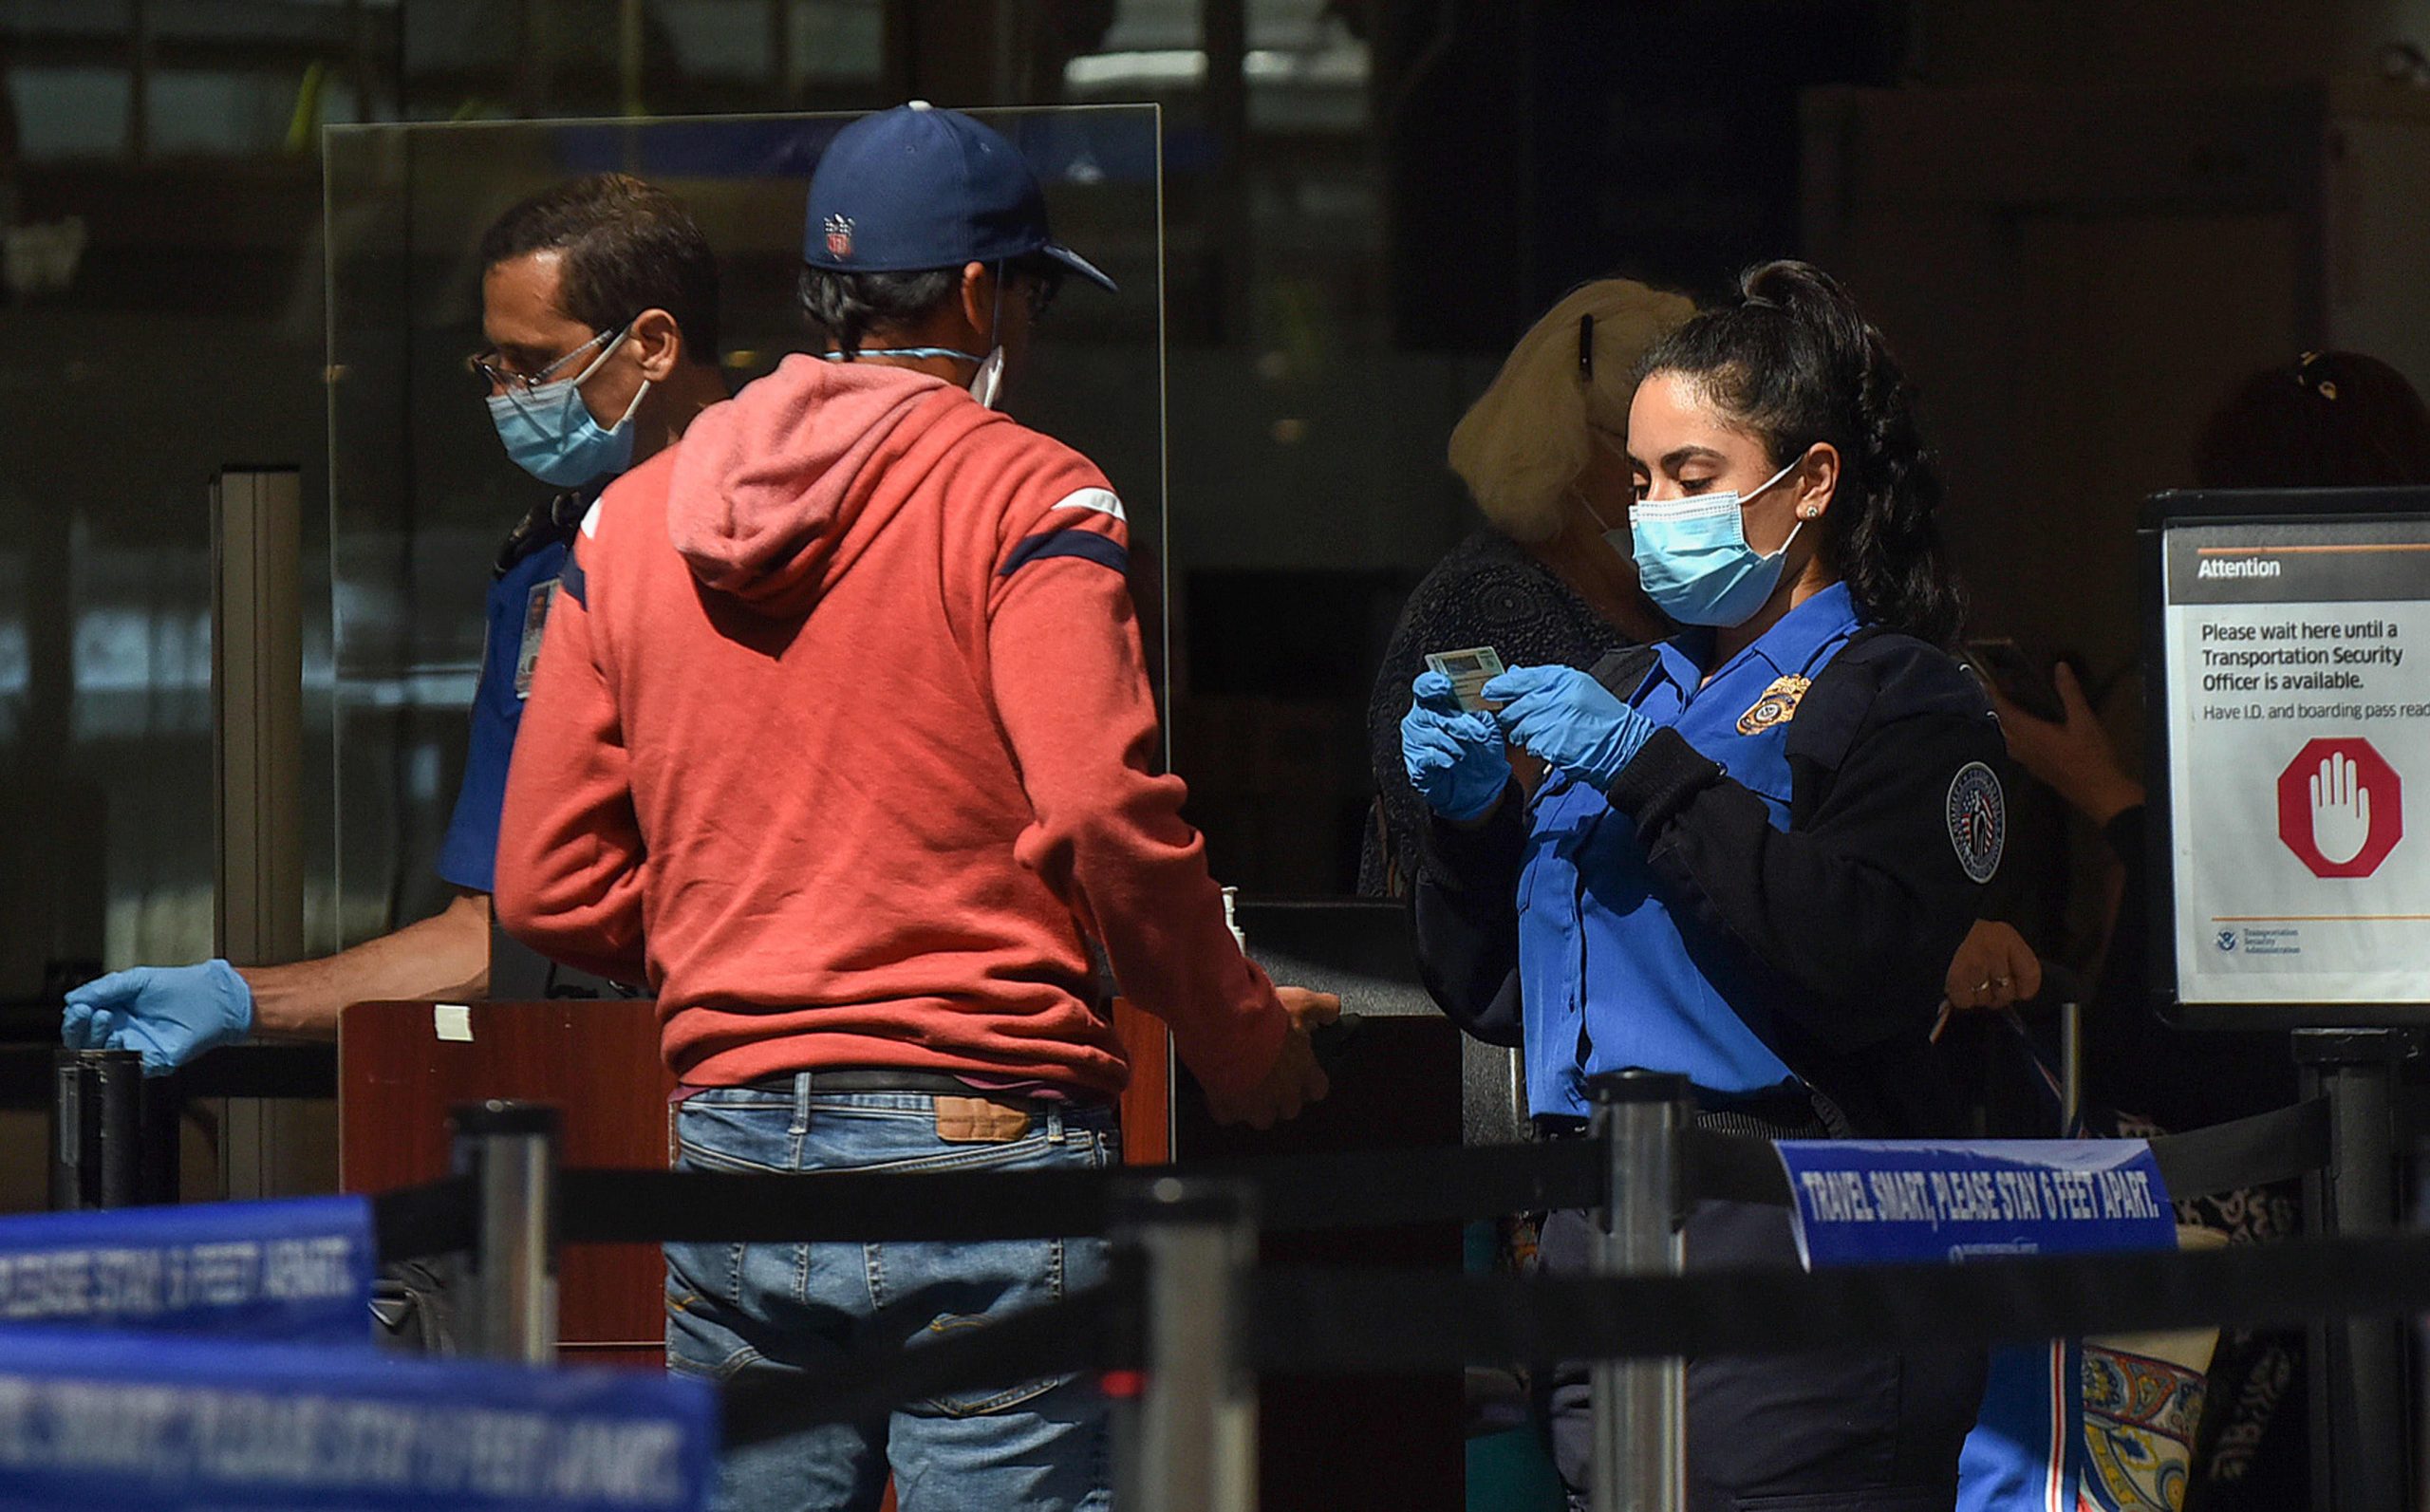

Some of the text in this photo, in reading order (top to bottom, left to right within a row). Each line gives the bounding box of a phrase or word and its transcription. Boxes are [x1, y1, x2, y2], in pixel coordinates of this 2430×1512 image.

[2197, 558, 2281, 579] Attention
[2202, 620, 2398, 641] Please wait here until a
[2202, 646, 2403, 668] Transportation Security
[2203, 671, 2365, 691] Officer is available.
[2204, 705, 2240, 720] Have
[2244, 704, 2265, 719] I.D.
[2269, 703, 2294, 719] and
[2298, 703, 2363, 720] boarding
[2365, 704, 2397, 719] pass
[1800, 1170, 1876, 1222] TRAVEL
[1930, 1170, 2000, 1221] PLEASE
[1995, 1170, 2042, 1221] STAY
[2040, 1171, 2057, 1221] 6
[2051, 1170, 2099, 1220] FEET
[2097, 1170, 2159, 1219] APART.
